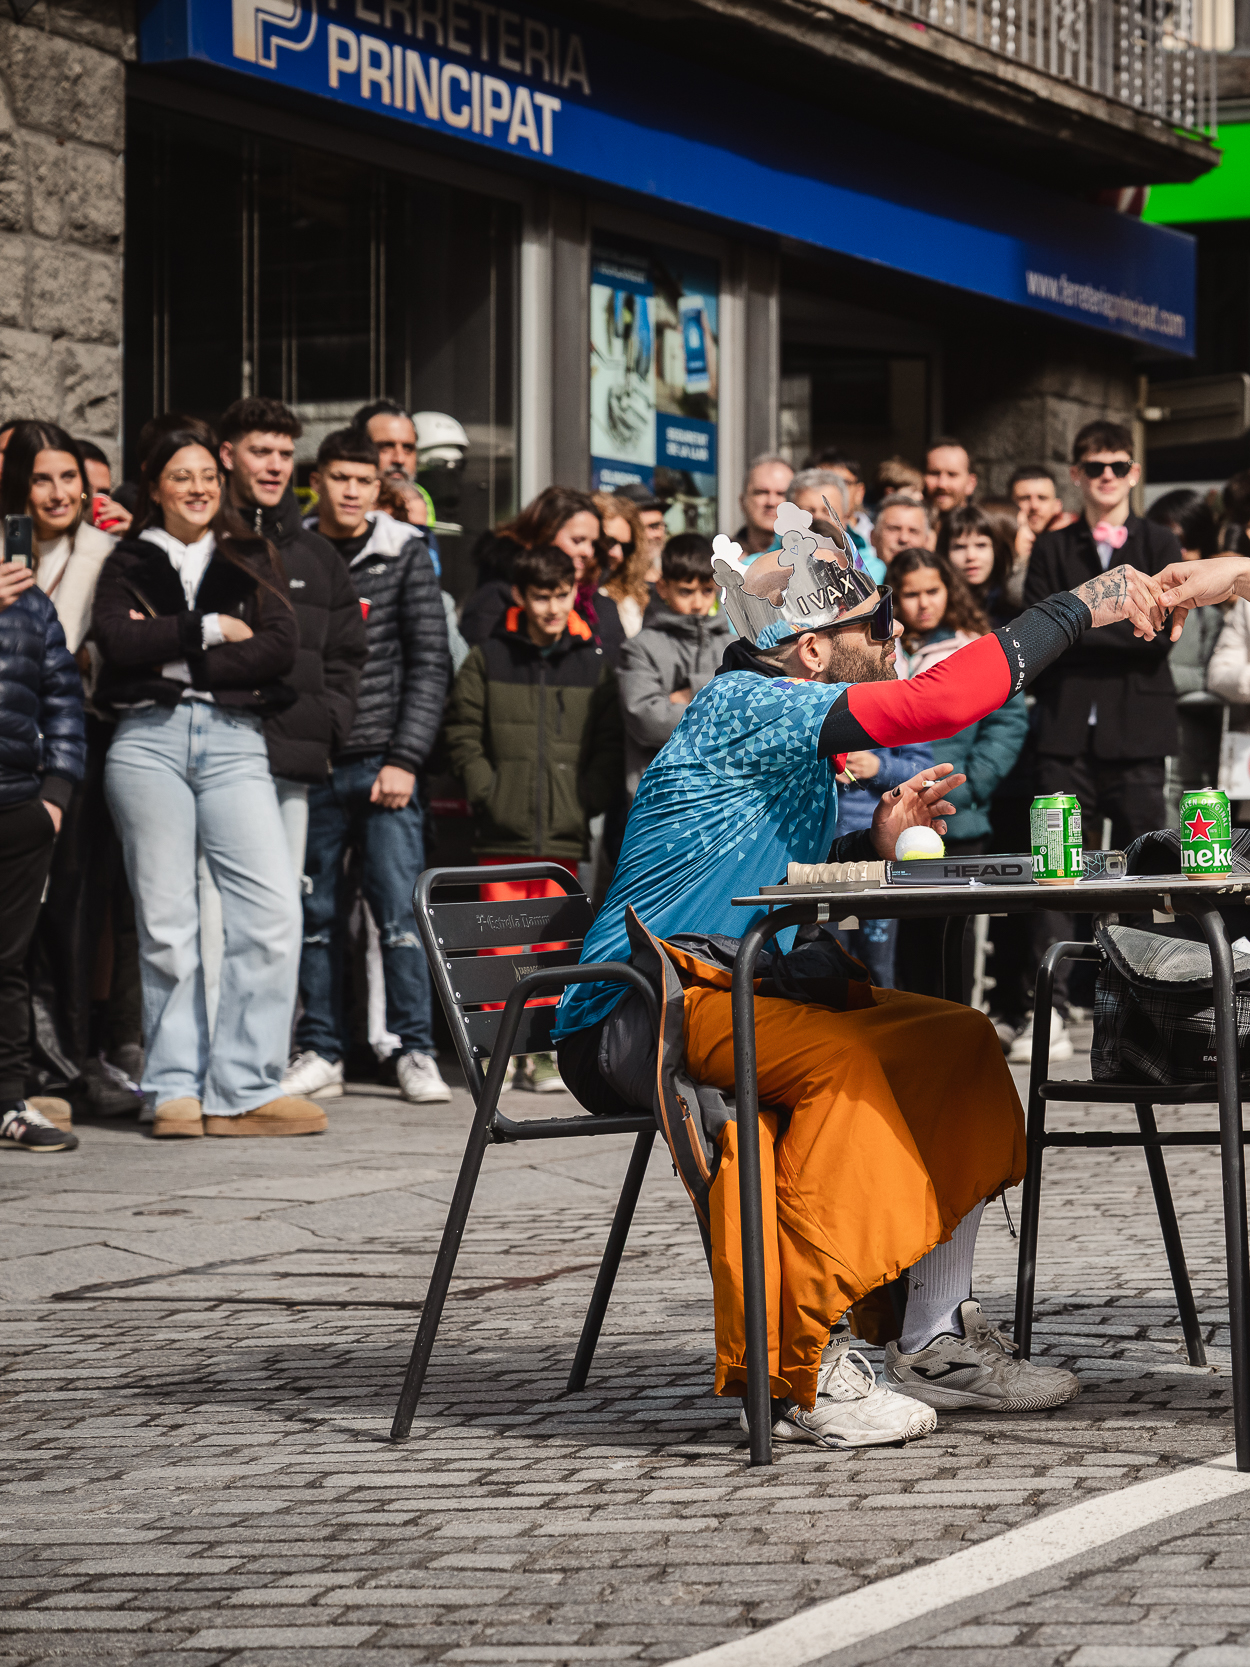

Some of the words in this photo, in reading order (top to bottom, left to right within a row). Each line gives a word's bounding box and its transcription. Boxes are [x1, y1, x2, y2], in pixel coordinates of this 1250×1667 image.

[327, 0, 592, 95] RRETERIA
[327, 23, 562, 156] PRINCIPAT
[797, 573, 854, 615] IVAX
[1201, 798, 1228, 827] ORIGINAL
[943, 863, 1024, 878] HEAD
